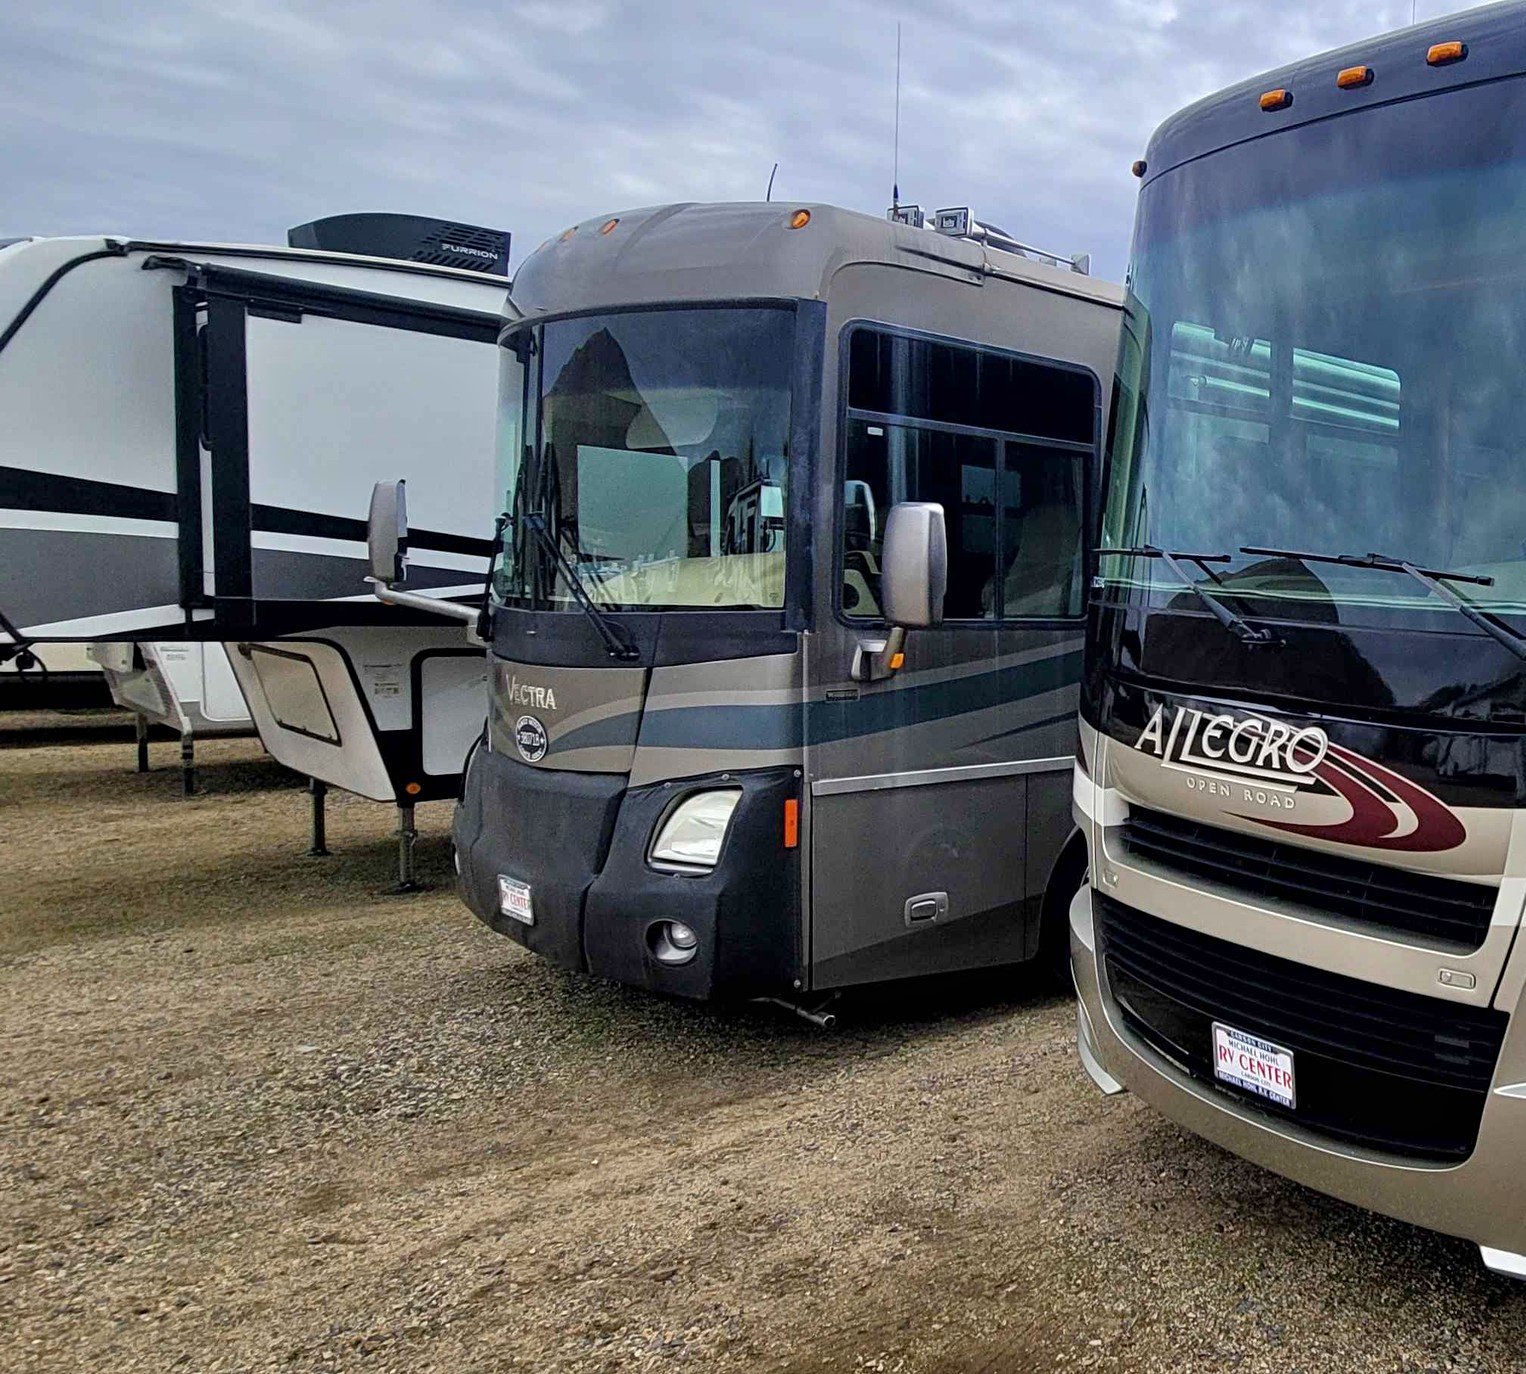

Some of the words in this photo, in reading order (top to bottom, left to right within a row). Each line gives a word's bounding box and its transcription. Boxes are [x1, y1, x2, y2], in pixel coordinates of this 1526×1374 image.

[441, 243, 498, 260] FURRION
[505, 673, 557, 710] VECTRA
[1134, 702, 1329, 787] ALLEGRO
[1186, 777, 1231, 797] OPEN
[1243, 789, 1296, 810] ROAD
[1218, 1044, 1235, 1064] RV
[1239, 1053, 1292, 1090] CENTER
